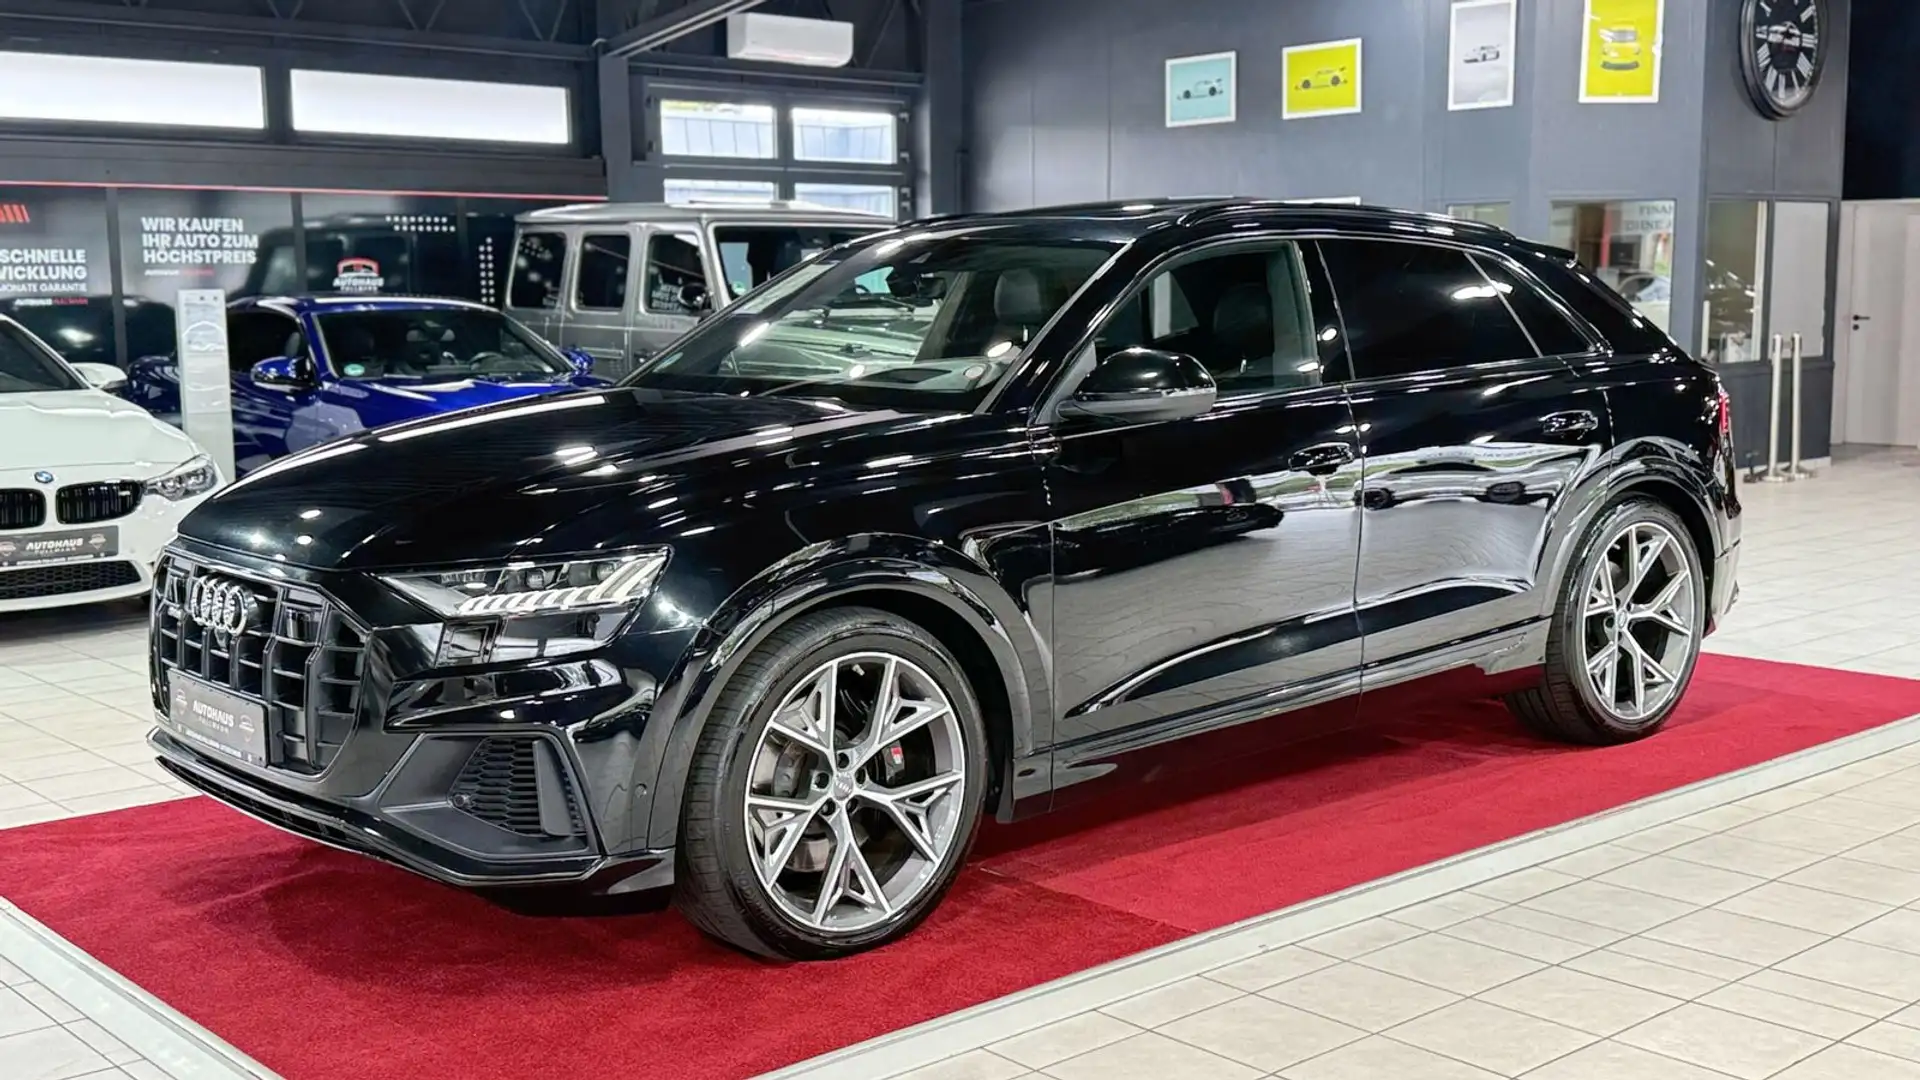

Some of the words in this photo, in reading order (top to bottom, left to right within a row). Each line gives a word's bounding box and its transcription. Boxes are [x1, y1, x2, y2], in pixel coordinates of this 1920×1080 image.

[141, 217, 176, 232] WIR
[178, 217, 243, 232] KAUFEN
[142, 233, 171, 248] IHR
[174, 233, 220, 249] AUTO
[221, 233, 259, 249] ZUM
[0, 248, 86, 263] SCHNELLE
[26, 537, 84, 551] AUTOHAUS
[193, 699, 234, 728] AUTOHAUS
